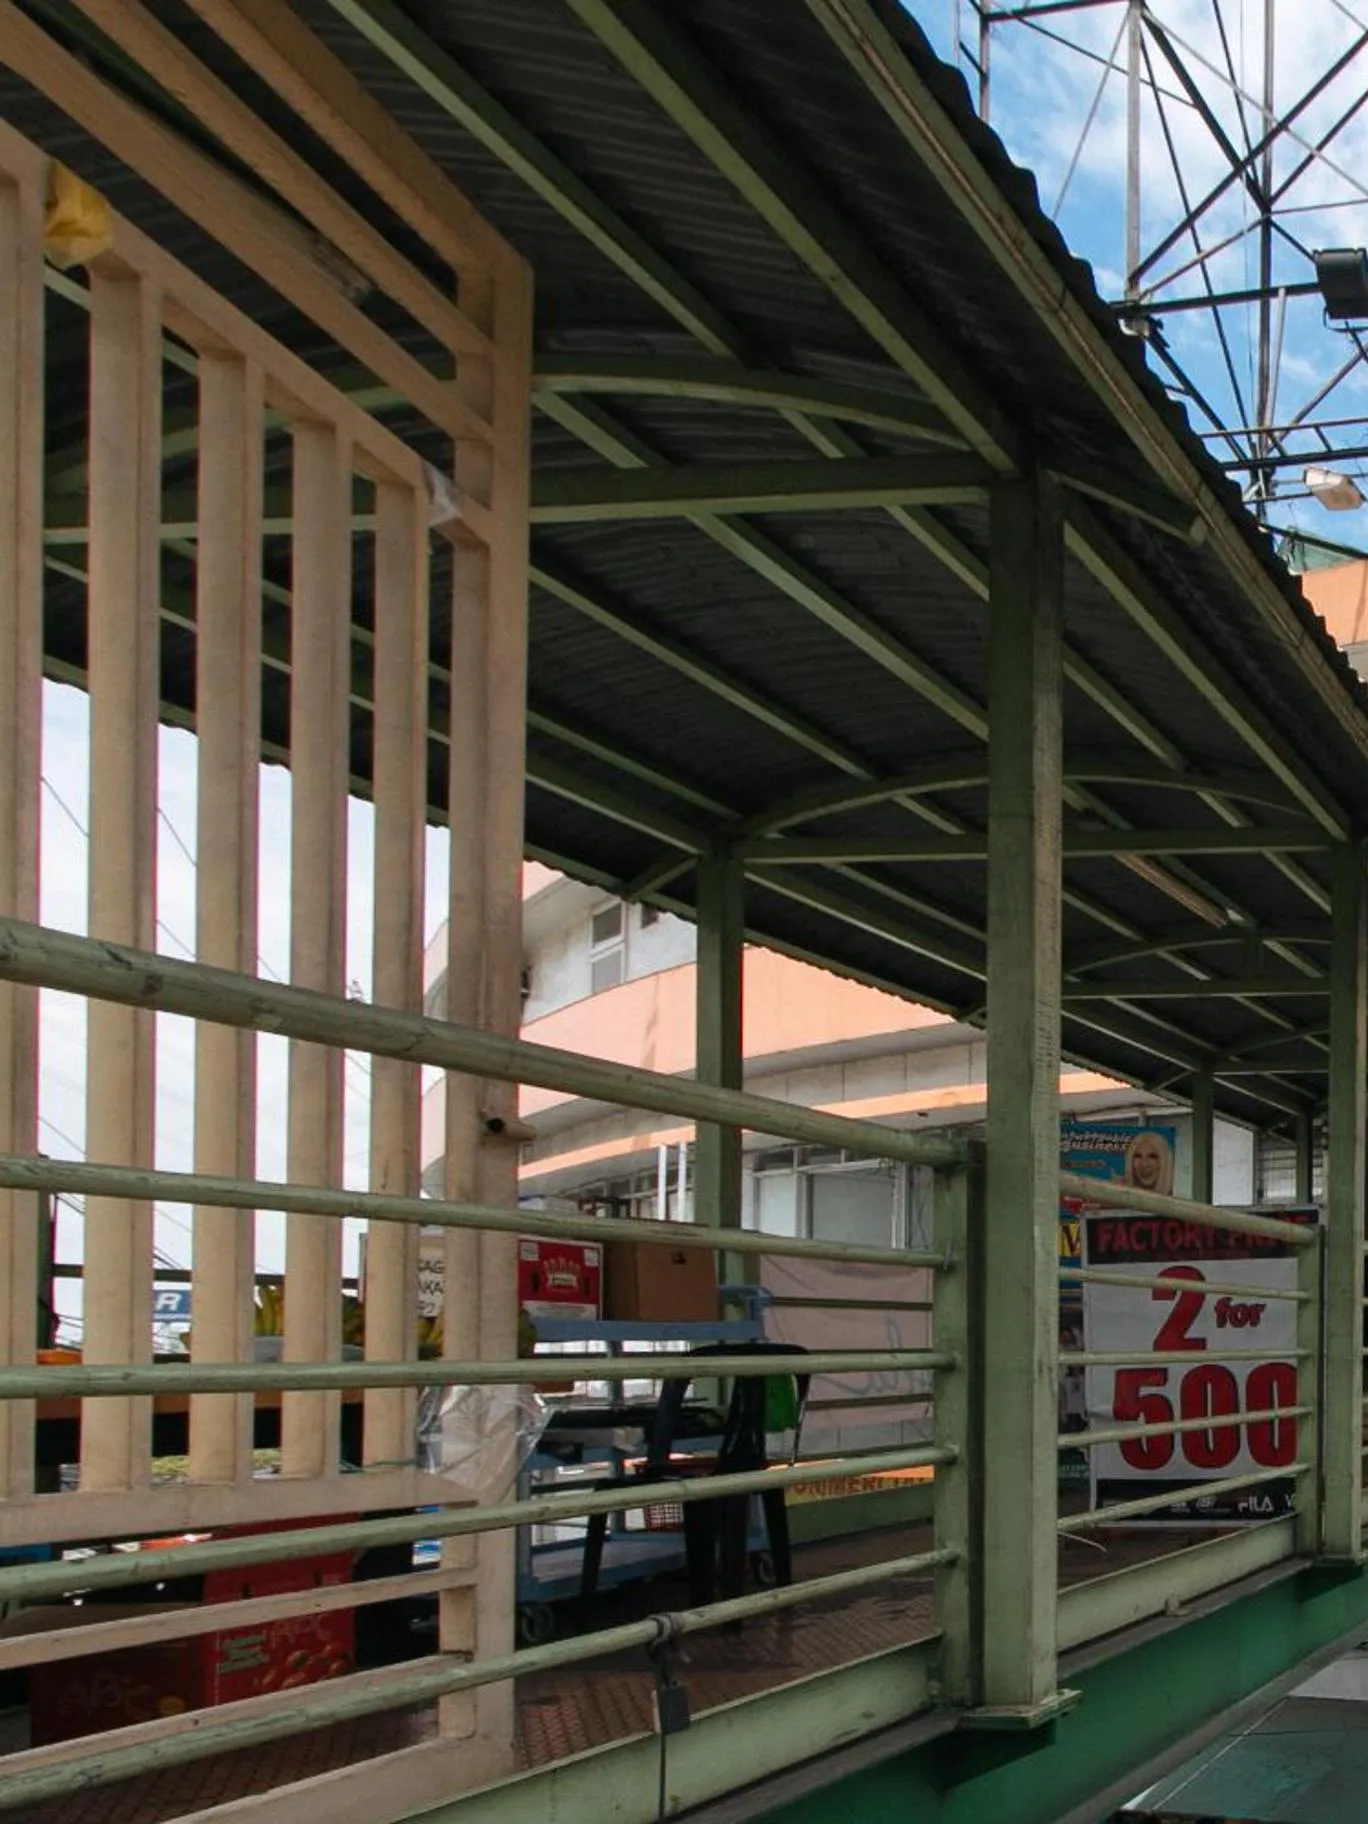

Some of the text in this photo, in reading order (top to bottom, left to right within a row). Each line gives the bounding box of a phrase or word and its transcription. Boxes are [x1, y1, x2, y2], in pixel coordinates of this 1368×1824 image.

[1152, 1265, 1266, 1351] 2 for
[1112, 1362, 1298, 1471] 500
